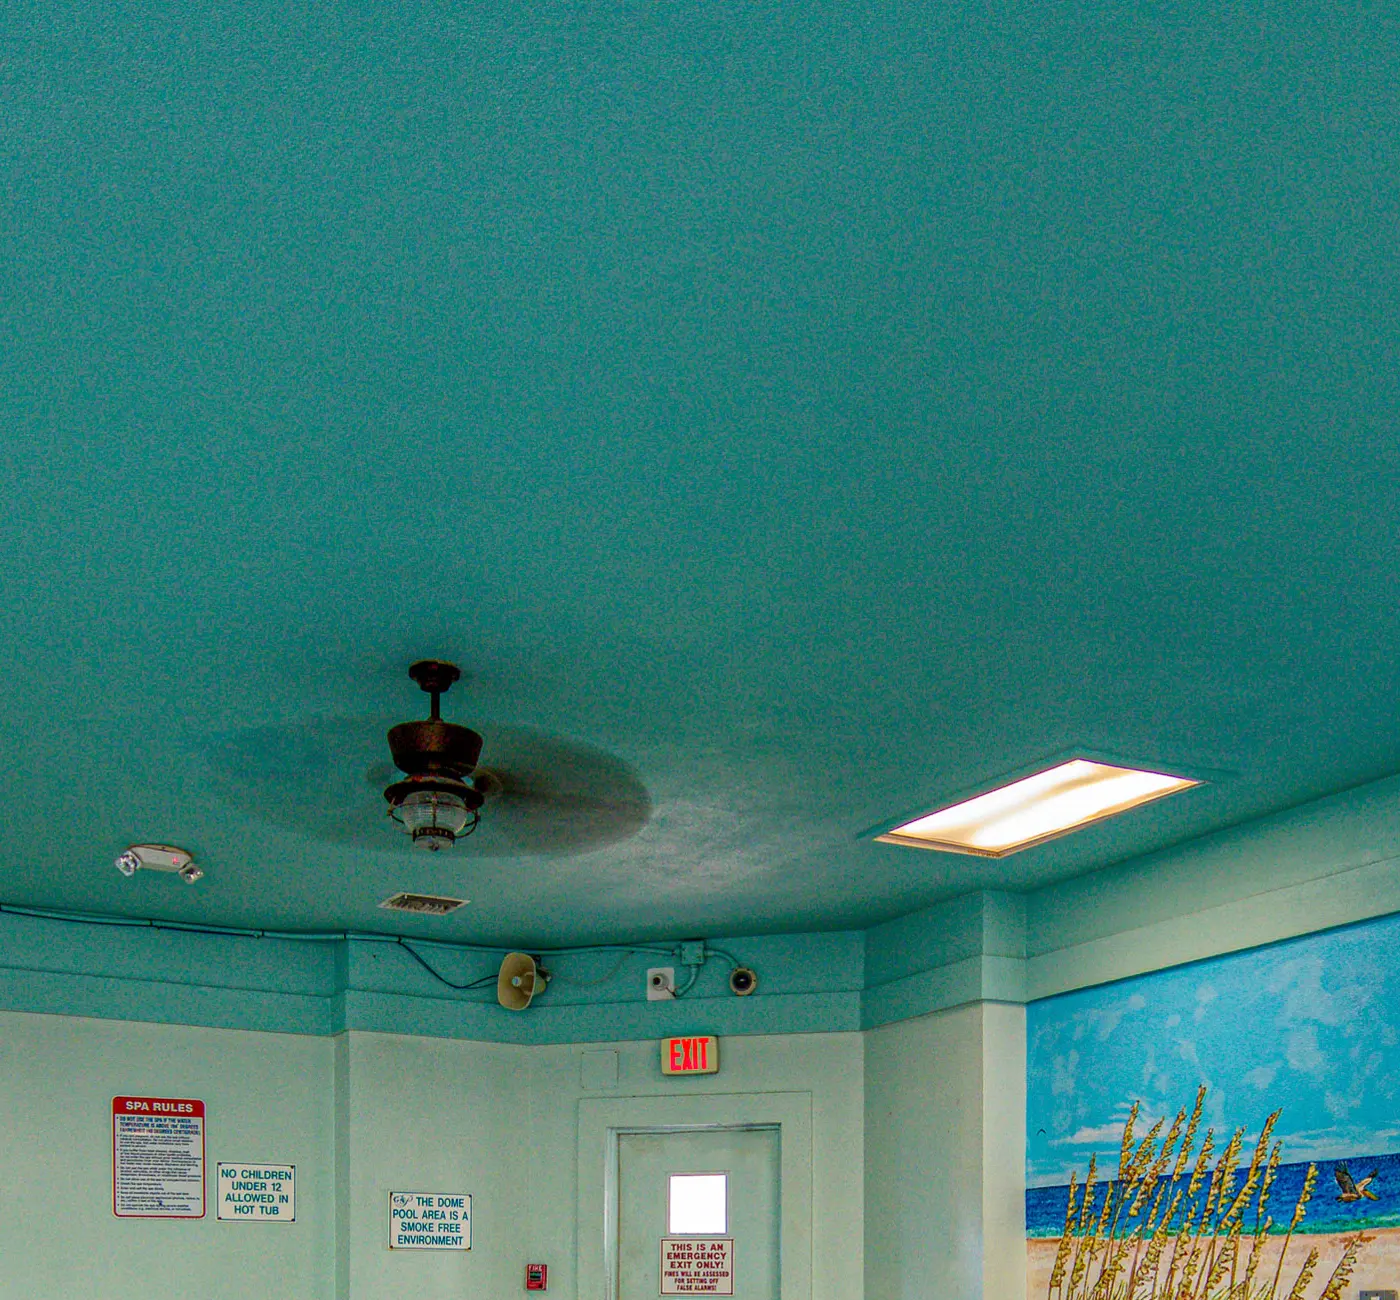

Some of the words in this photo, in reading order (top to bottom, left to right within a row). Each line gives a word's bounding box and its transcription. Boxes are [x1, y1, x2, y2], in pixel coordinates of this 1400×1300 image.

[670, 1037, 709, 1071] EXIT
[126, 1101, 149, 1111] SPA
[153, 1102, 193, 1113] RULES
[221, 1168, 237, 1178] NO
[241, 1169, 292, 1180] CHILDREN
[231, 1181, 267, 1191] UNDER
[271, 1182, 282, 1192] 12
[225, 1193, 275, 1203] ALLOWED
[279, 1194, 289, 1203] IN
[416, 1196, 434, 1207] THE
[438, 1197, 465, 1208] DOME
[234, 1205, 255, 1214] HOT
[259, 1206, 279, 1215] TUB
[392, 1209, 418, 1219] POOL
[421, 1209, 446, 1220] AREA
[450, 1210, 458, 1220] IS
[462, 1211, 469, 1220] A
[400, 1221, 434, 1232] SMOKE
[438, 1223, 461, 1233] FREE
[397, 1234, 464, 1245] ENVIRONMENT
[671, 1243, 693, 1251] THIS
[696, 1243, 706, 1251] IS
[710, 1243, 724, 1251] AN
[666, 1252, 727, 1260] EMERGENCY
[670, 1261, 692, 1269] EXIT
[696, 1261, 724, 1269] ONLY!
